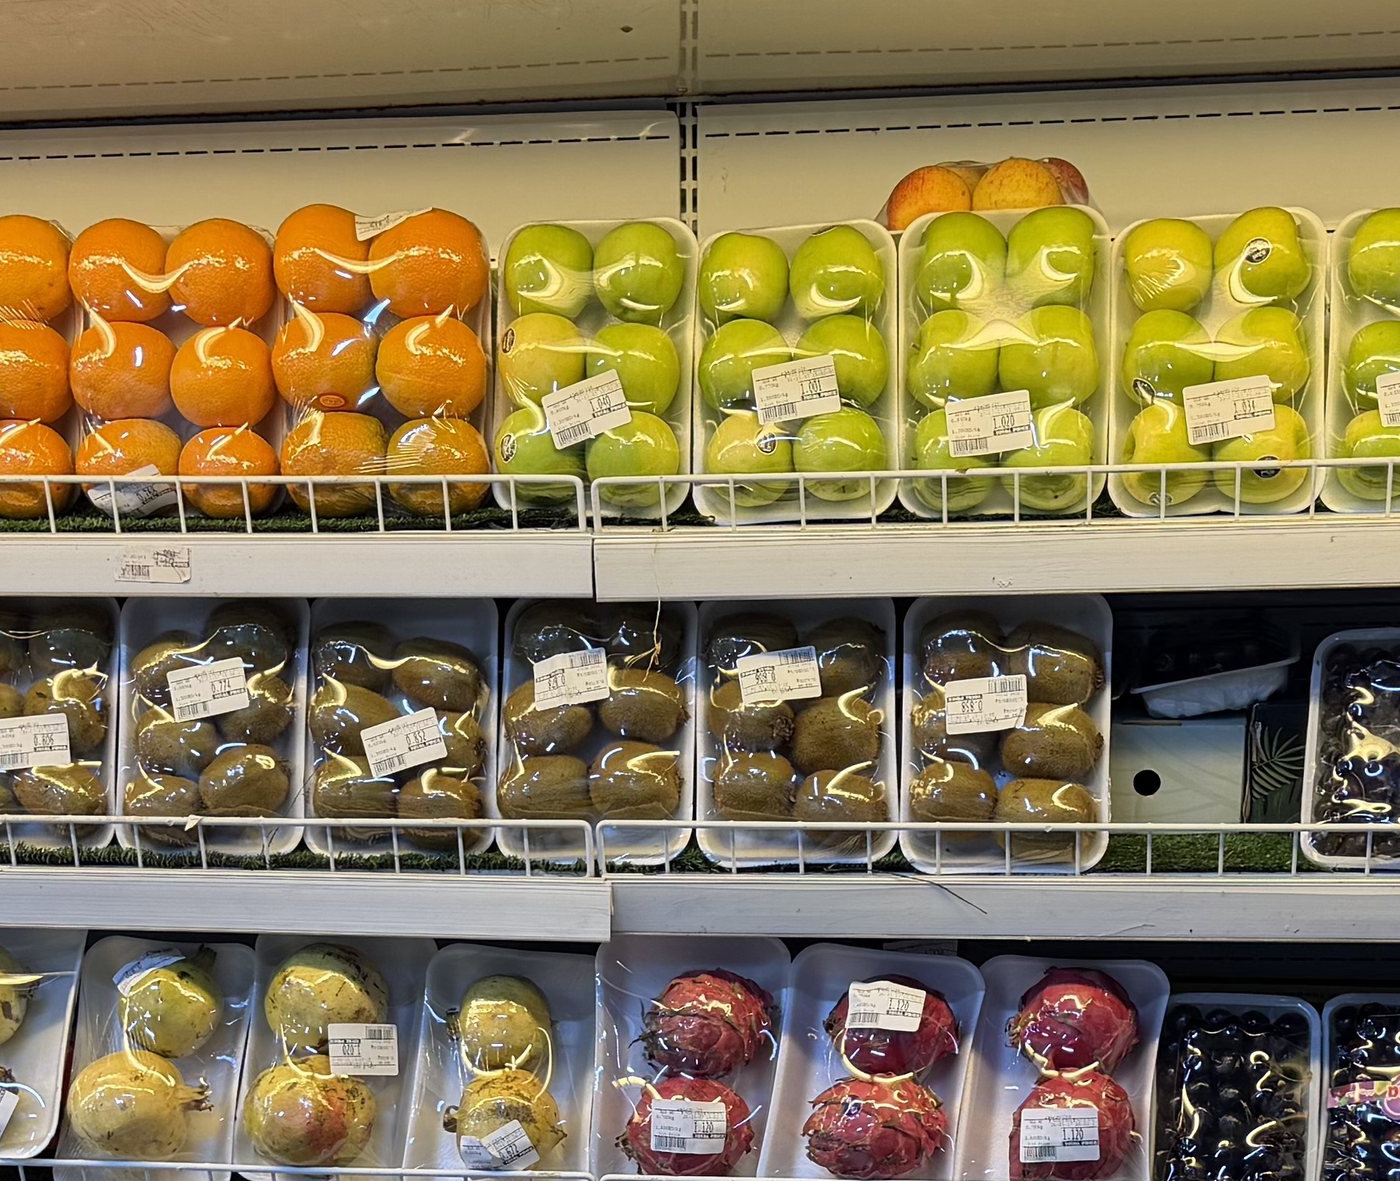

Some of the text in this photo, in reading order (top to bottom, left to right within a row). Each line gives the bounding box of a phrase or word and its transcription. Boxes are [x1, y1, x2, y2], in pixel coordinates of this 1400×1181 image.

[993, 415, 1015, 429] 1.020
[694, 1121, 714, 1134] 1.120
[1063, 1128, 1084, 1141] 1.120
